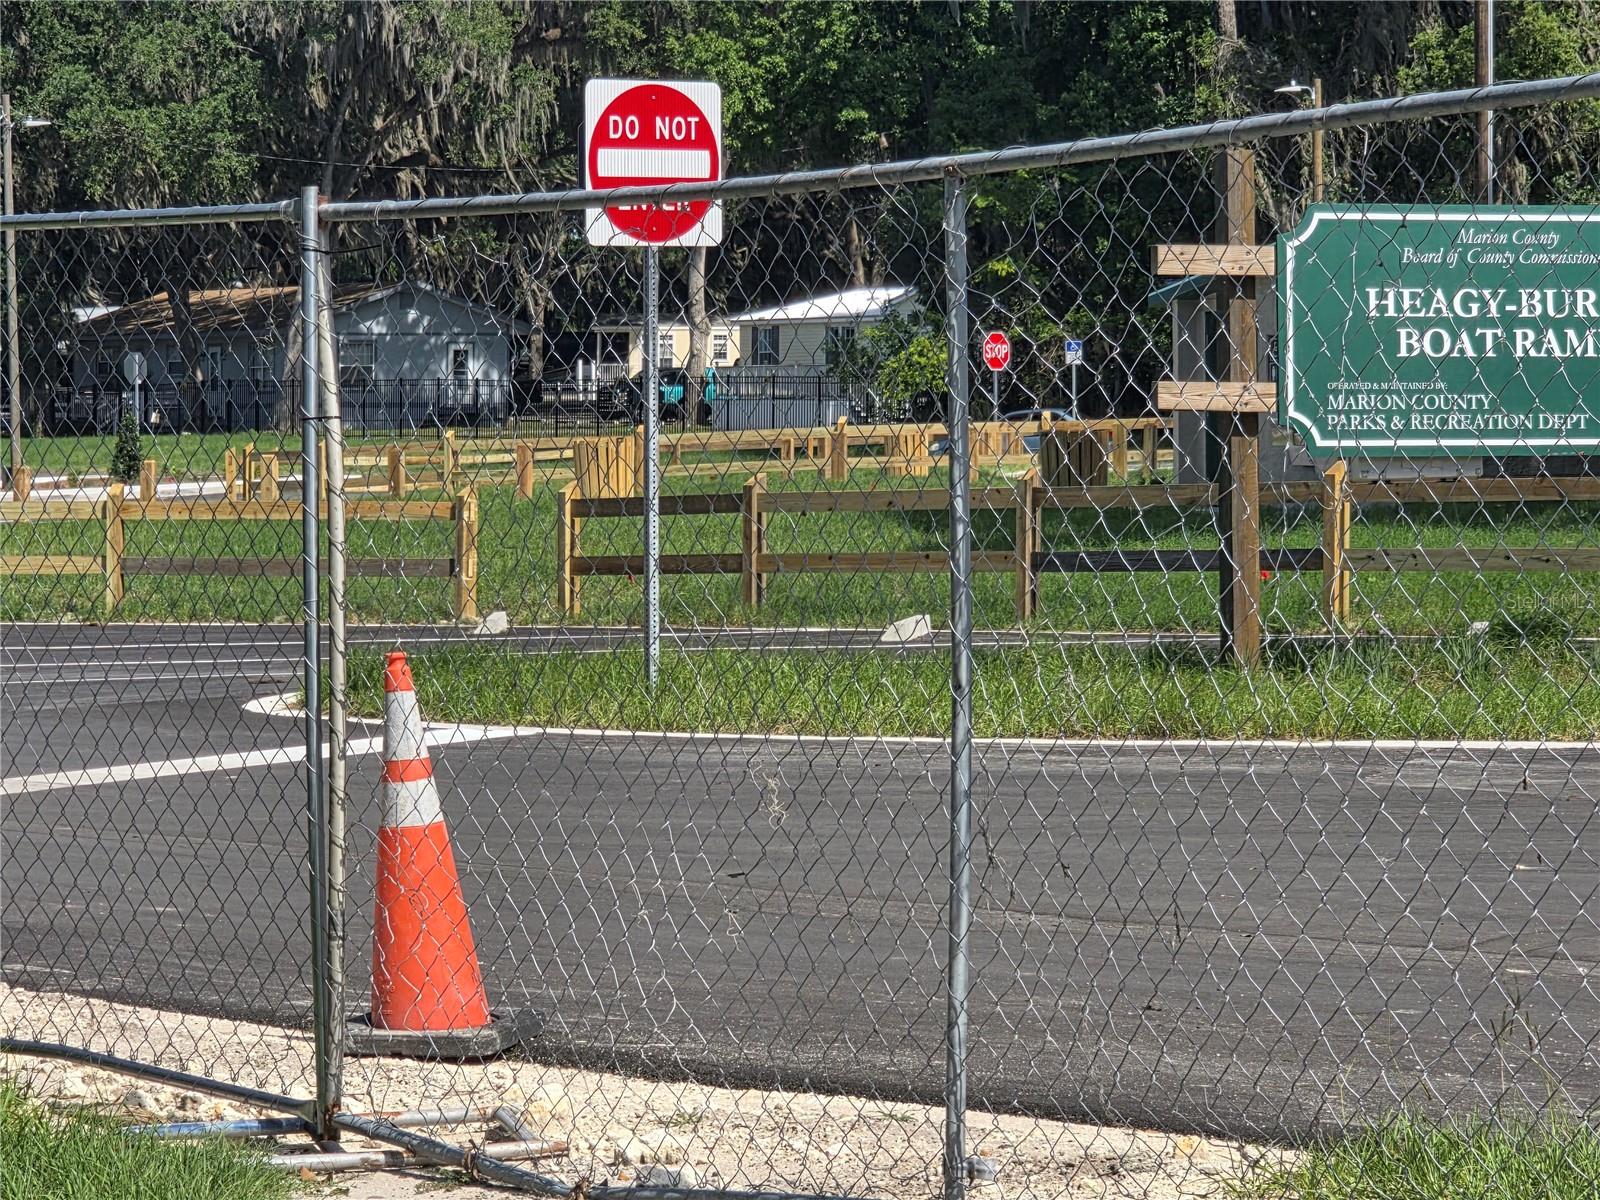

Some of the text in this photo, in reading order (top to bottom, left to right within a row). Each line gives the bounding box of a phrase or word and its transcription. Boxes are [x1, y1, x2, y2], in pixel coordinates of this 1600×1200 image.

[608, 115, 699, 141] DO NOT
[1457, 228, 1560, 249] Marion County
[1402, 247, 1444, 264] Board
[1446, 247, 1462, 268] of
[1467, 248, 1515, 268] County
[1366, 288, 1600, 318] HEAGY-BUR
[985, 344, 1008, 358] STOP
[1396, 327, 1600, 358] BOAT RAM
[1327, 382, 1372, 390] OPERATED
[1372, 382, 1380, 390] &
[1380, 382, 1434, 390] MAINTAINED
[1327, 394, 1493, 410] MARION COUNTY
[1327, 414, 1589, 430] PARKS & RECREATION DEPT
